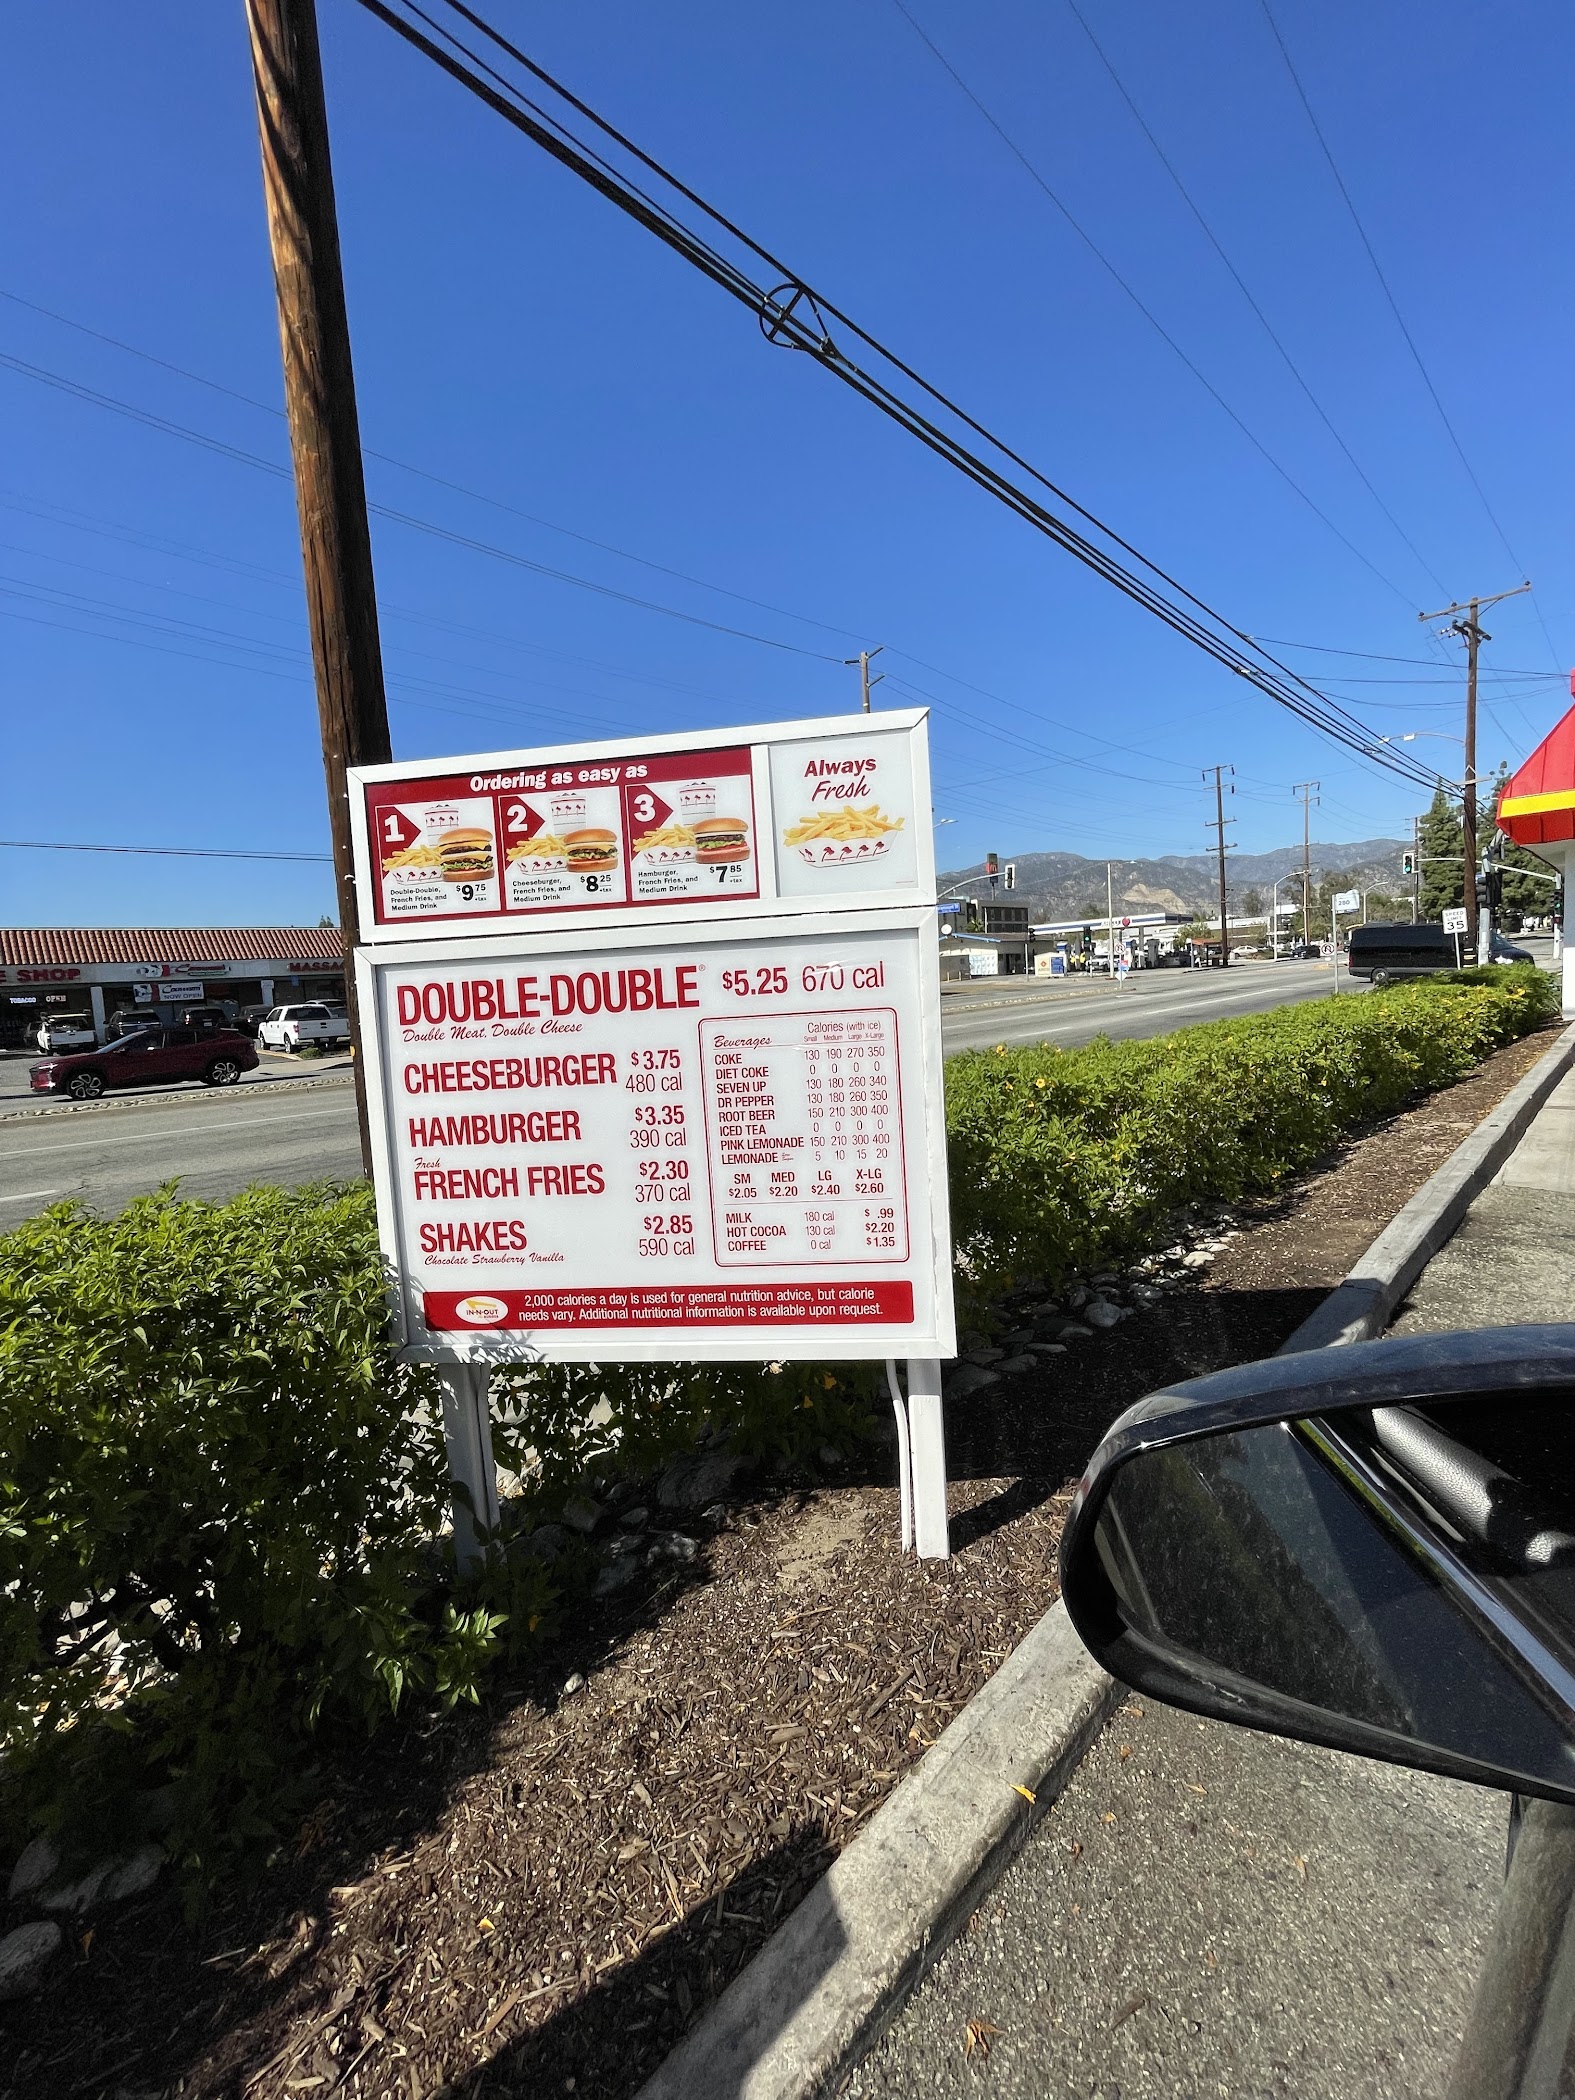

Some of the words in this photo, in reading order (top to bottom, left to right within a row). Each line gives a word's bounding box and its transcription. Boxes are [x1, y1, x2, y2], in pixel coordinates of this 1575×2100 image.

[804, 758, 877, 777] Always
[470, 771, 547, 792] Ordering
[551, 771, 573, 785] as
[578, 767, 620, 783] easy
[625, 765, 648, 778] as
[812, 775, 870, 801] Fresh
[634, 794, 656, 822] 3
[507, 805, 528, 832] 2
[384, 815, 405, 842] 1
[638, 878, 661, 886] French
[639, 886, 667, 894] Medium
[669, 884, 688, 892] Drink
[513, 887, 536, 895] French
[513, 895, 541, 903] Medium
[543, 893, 561, 901] Drink
[391, 896, 413, 904] French
[420, 902, 437, 910] Drink
[1447, 921, 1465, 930] 35
[289, 962, 344, 972] MASSA
[17, 969, 80, 982] SHOP
[722, 967, 788, 997] $5.25
[802, 964, 844, 992] 670
[852, 960, 885, 989] cal
[402, 1029, 445, 1043] Double
[491, 1023, 535, 1038] Double
[540, 1019, 583, 1034] Cheese
[807, 1022, 844, 1034] Calories
[846, 1021, 865, 1032] (with
[867, 1020, 881, 1031] ice)
[713, 1035, 772, 1050] Beverages
[847, 1033, 862, 1041] Large
[864, 1032, 885, 1040] X-Large
[714, 1053, 742, 1065] COKE
[804, 1049, 820, 1060] 130
[826, 1048, 842, 1059] 190
[847, 1047, 864, 1058] 270
[868, 1046, 885, 1057] 350
[404, 1052, 618, 1095] CHEESEBURGER
[716, 1068, 738, 1079] DIET
[741, 1066, 769, 1078] COKE
[625, 1074, 655, 1093] 480
[661, 1072, 683, 1091] cal
[716, 1082, 750, 1094] SEVEN
[753, 1081, 767, 1092] UP
[806, 1079, 821, 1090] 130
[828, 1078, 844, 1089] 180
[848, 1076, 866, 1087] 260
[869, 1075, 887, 1086] 340
[718, 1097, 733, 1108] DR
[735, 1095, 774, 1107] PEPPER
[807, 1093, 822, 1104] 130
[829, 1092, 844, 1103] 180
[849, 1091, 866, 1102] 260
[870, 1089, 887, 1100] 350
[635, 1105, 685, 1126] $3.35
[719, 1111, 747, 1122] ROOT
[750, 1109, 775, 1121] BEER
[808, 1108, 823, 1118] 150
[829, 1106, 845, 1117] 210
[850, 1105, 867, 1116] 300
[871, 1104, 888, 1115] 400
[409, 1110, 581, 1148] HAMBURGER
[720, 1125, 742, 1136] ICED
[745, 1124, 766, 1135] TEA
[630, 1129, 660, 1148] 390
[665, 1128, 687, 1147] cal
[720, 1139, 744, 1150] PINK
[747, 1137, 804, 1150] LEMONADE
[810, 1136, 825, 1147] 150
[831, 1135, 847, 1146] 210
[852, 1134, 869, 1145] 300
[872, 1133, 890, 1144] 400
[721, 1152, 778, 1165] LEMONADE
[876, 1148, 888, 1158] 20
[414, 1157, 441, 1170] Fresh
[639, 1160, 689, 1180] $2.30
[414, 1167, 519, 1200] FRENCH
[527, 1164, 606, 1196] FRIES
[734, 1173, 751, 1184] SM
[771, 1171, 795, 1183] MED
[818, 1170, 832, 1181] LG
[856, 1168, 882, 1180] X-LG
[635, 1184, 664, 1203] 370
[669, 1182, 691, 1201] cal
[728, 1187, 757, 1198] $2.05
[769, 1186, 798, 1197] $2.20
[811, 1184, 840, 1195] $2.40
[855, 1182, 884, 1194] $2.60
[725, 1212, 752, 1224] MILK
[804, 1211, 820, 1222] 180
[822, 1210, 835, 1221] cal
[643, 1215, 693, 1235] $2.85
[727, 1226, 747, 1238] HOT
[750, 1225, 786, 1237] COCOA
[805, 1225, 821, 1236] 130
[823, 1224, 835, 1235] cal
[865, 1222, 895, 1233] $2.20
[419, 1220, 528, 1253] SHAKES
[819, 1238, 831, 1249] cal
[866, 1237, 895, 1248] $1.35
[639, 1239, 668, 1257] 590
[673, 1237, 695, 1255] cal
[728, 1240, 767, 1252] COFFEE
[424, 1255, 469, 1266] Chocolate
[472, 1253, 526, 1266] Strawberry
[529, 1252, 565, 1263] Vanilla
[525, 1294, 554, 1308] 2,000
[557, 1293, 596, 1306] calories
[600, 1296, 606, 1305] a
[609, 1292, 627, 1307] day
[630, 1292, 638, 1304] is
[642, 1291, 667, 1304] used
[671, 1291, 685, 1303] for
[688, 1290, 726, 1305] general
[730, 1289, 773, 1302] nutrition
[776, 1288, 813, 1302] advice,
[817, 1288, 835, 1300] but
[838, 1287, 875, 1300] calorie
[519, 1309, 549, 1321] needs
[551, 1310, 576, 1323] vary.
[579, 1307, 628, 1320] Additional
[631, 1306, 682, 1319] nutritional
[686, 1305, 744, 1318] information
[748, 1304, 757, 1316] is
[759, 1303, 805, 1316] available
[809, 1305, 835, 1318] upon
[839, 1303, 883, 1317] request.
